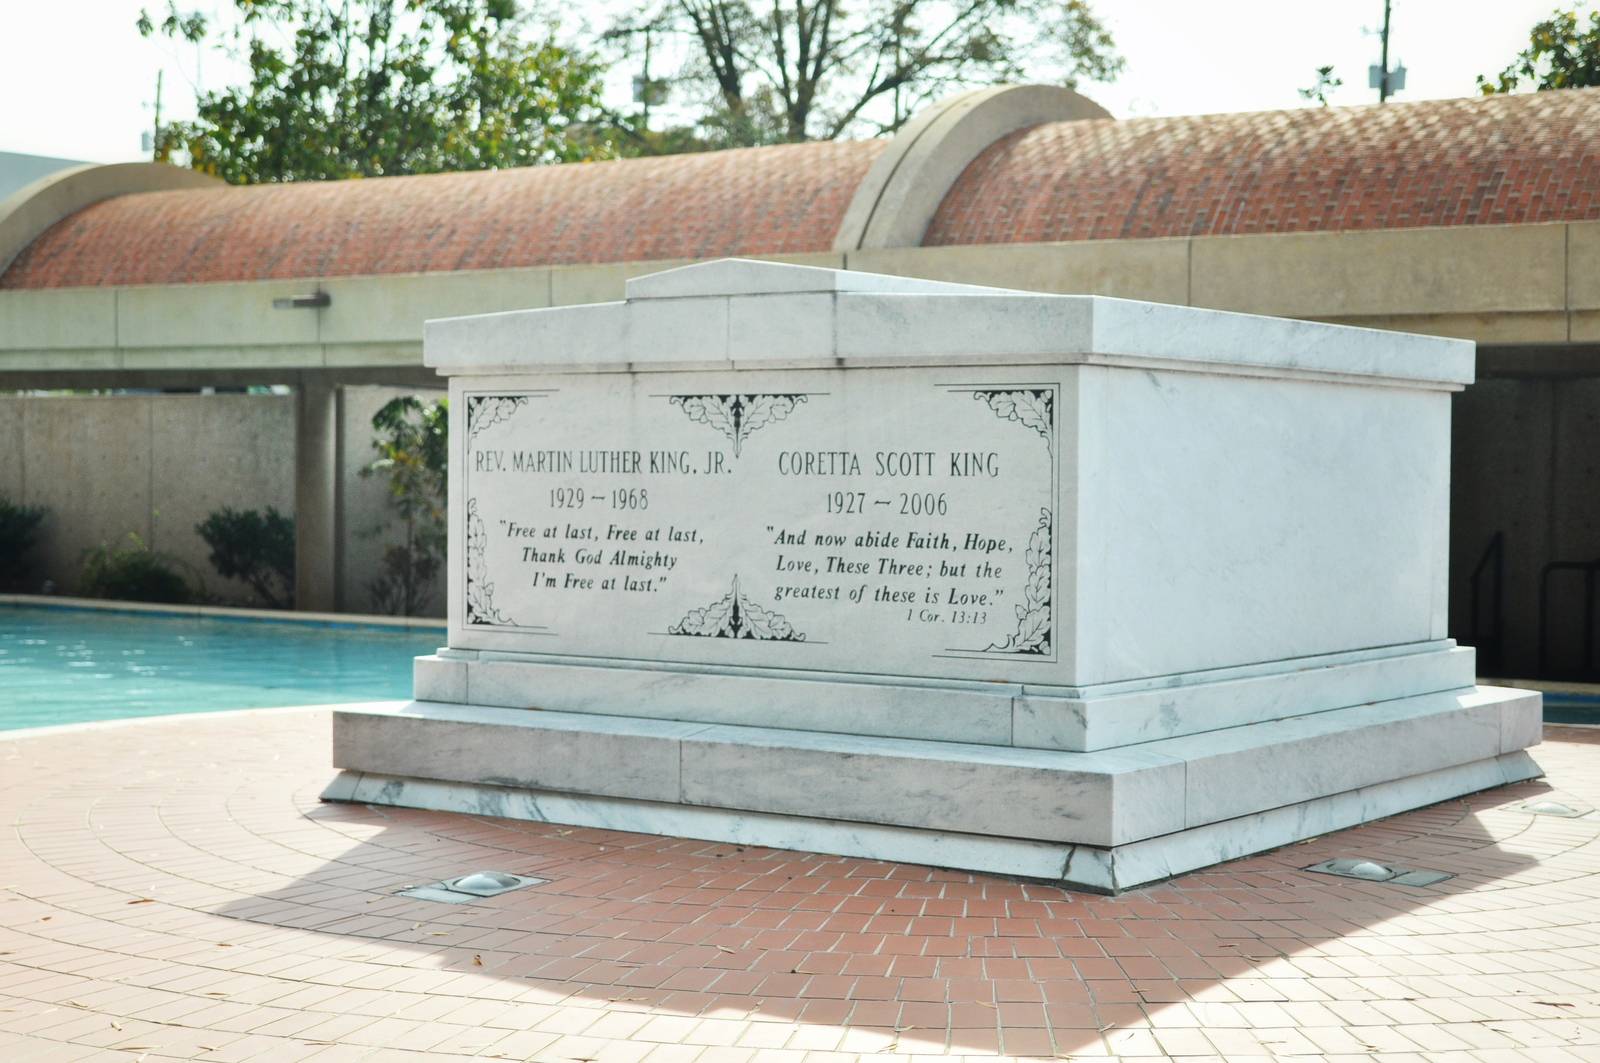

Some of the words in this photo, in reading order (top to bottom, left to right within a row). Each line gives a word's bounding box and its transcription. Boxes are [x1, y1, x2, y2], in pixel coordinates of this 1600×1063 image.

[475, 450, 507, 472] REV.
[512, 450, 573, 474] MARTIN
[579, 450, 642, 474] LUTHER
[649, 451, 698, 475] KING,
[704, 451, 733, 475] JR.
[778, 451, 862, 476] CORETTA
[875, 452, 936, 477] SCOTT
[950, 452, 1000, 477] KING
[550, 487, 585, 509] 1929
[611, 488, 649, 510] 1968
[827, 492, 866, 514] 1927
[899, 492, 948, 516] 2006
[543, 524, 558, 539] at
[565, 524, 599, 542] last,
[606, 524, 638, 541] Free
[645, 527, 660, 541] at
[668, 526, 704, 545] last,
[814, 533, 847, 547] now
[855, 531, 900, 548] abide
[906, 532, 958, 552] Faith,
[963, 533, 1013, 554] Hope,
[521, 546, 566, 563] Thank
[575, 548, 602, 566] God
[609, 550, 678, 570] Almighty
[776, 555, 819, 575] Love,
[826, 556, 870, 575] These
[878, 558, 933, 579] Three;
[939, 560, 966, 578] but
[975, 561, 1003, 579] the
[532, 572, 557, 588] I'm
[564, 573, 594, 590] Free
[601, 577, 616, 590] at
[774, 584, 840, 601] greatest
[849, 584, 868, 603] of
[874, 586, 916, 603] these
[925, 587, 940, 604] is
[907, 609, 913, 622] 1
[919, 610, 945, 623] Cor.
[951, 610, 987, 624] 13:13
